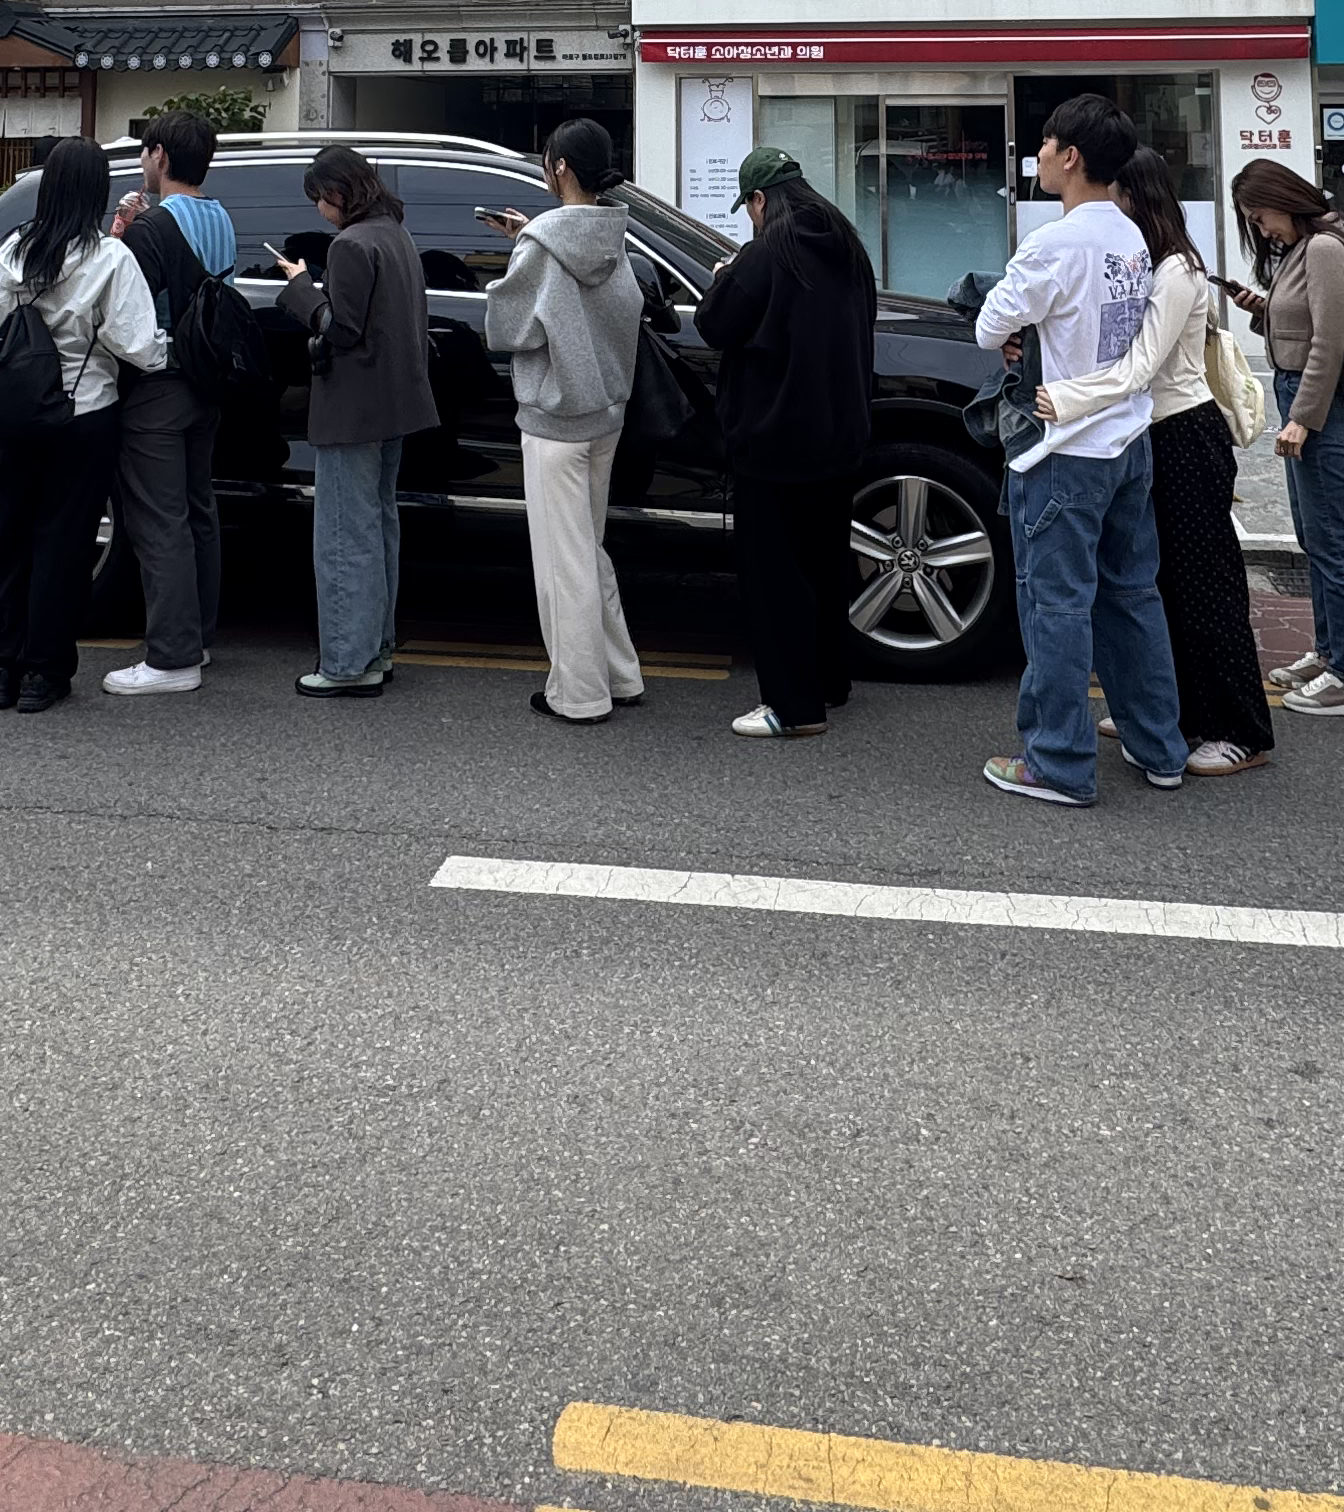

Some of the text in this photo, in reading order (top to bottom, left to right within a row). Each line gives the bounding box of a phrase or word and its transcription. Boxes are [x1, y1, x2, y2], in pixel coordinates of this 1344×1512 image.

[390, 37, 557, 64] 해오름아파트
[666, 45, 824, 59] 닥터훈 소아청소년과 의원
